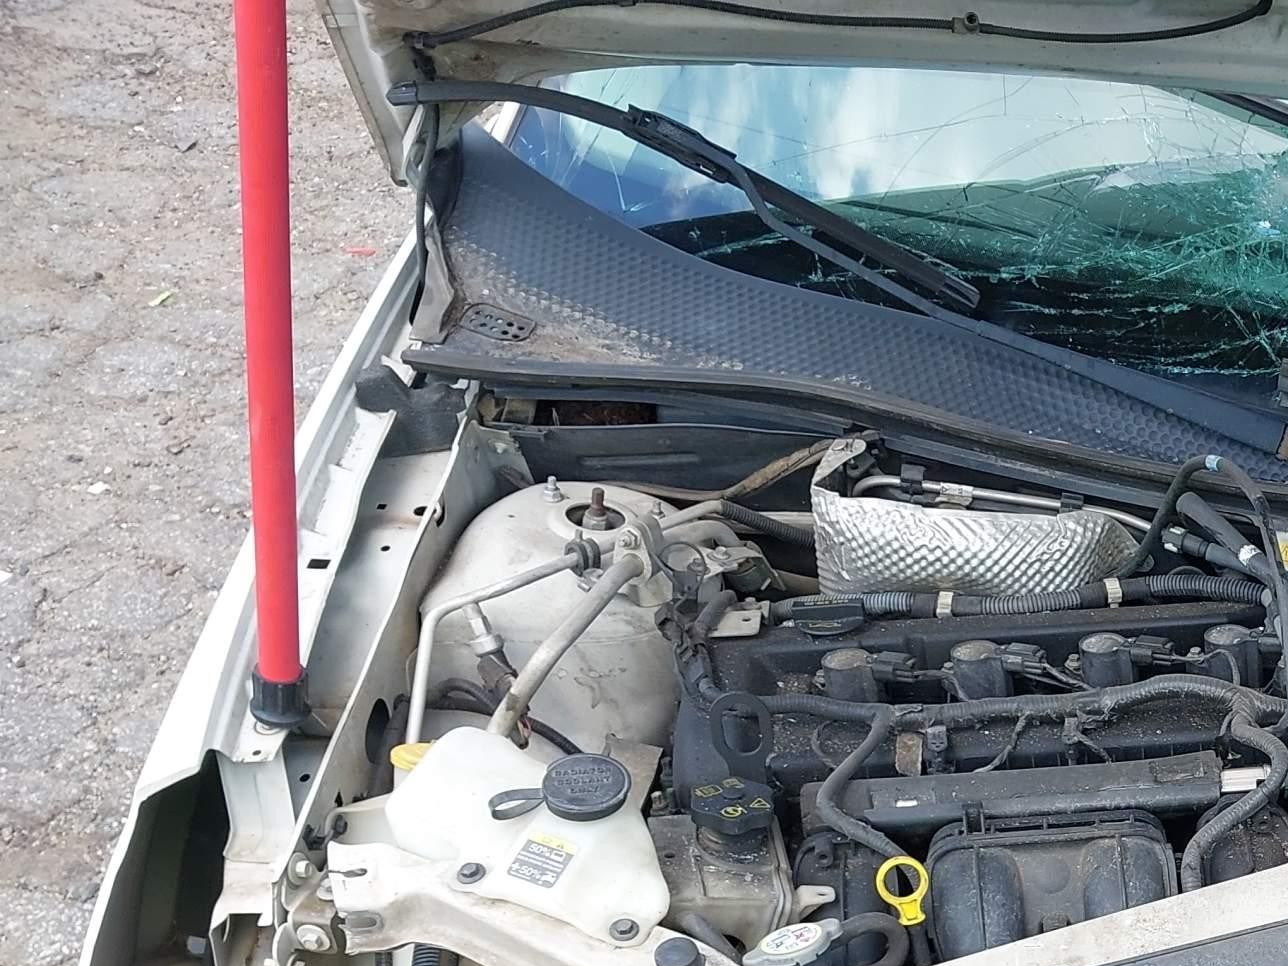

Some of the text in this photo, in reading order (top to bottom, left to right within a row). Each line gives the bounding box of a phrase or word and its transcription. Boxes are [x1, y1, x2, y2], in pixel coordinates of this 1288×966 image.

[552, 767, 611, 777] RADIATOR
[554, 775, 610, 786] COOLANT
[569, 786, 599, 794] ONLY
[529, 843, 552, 857] 50%
